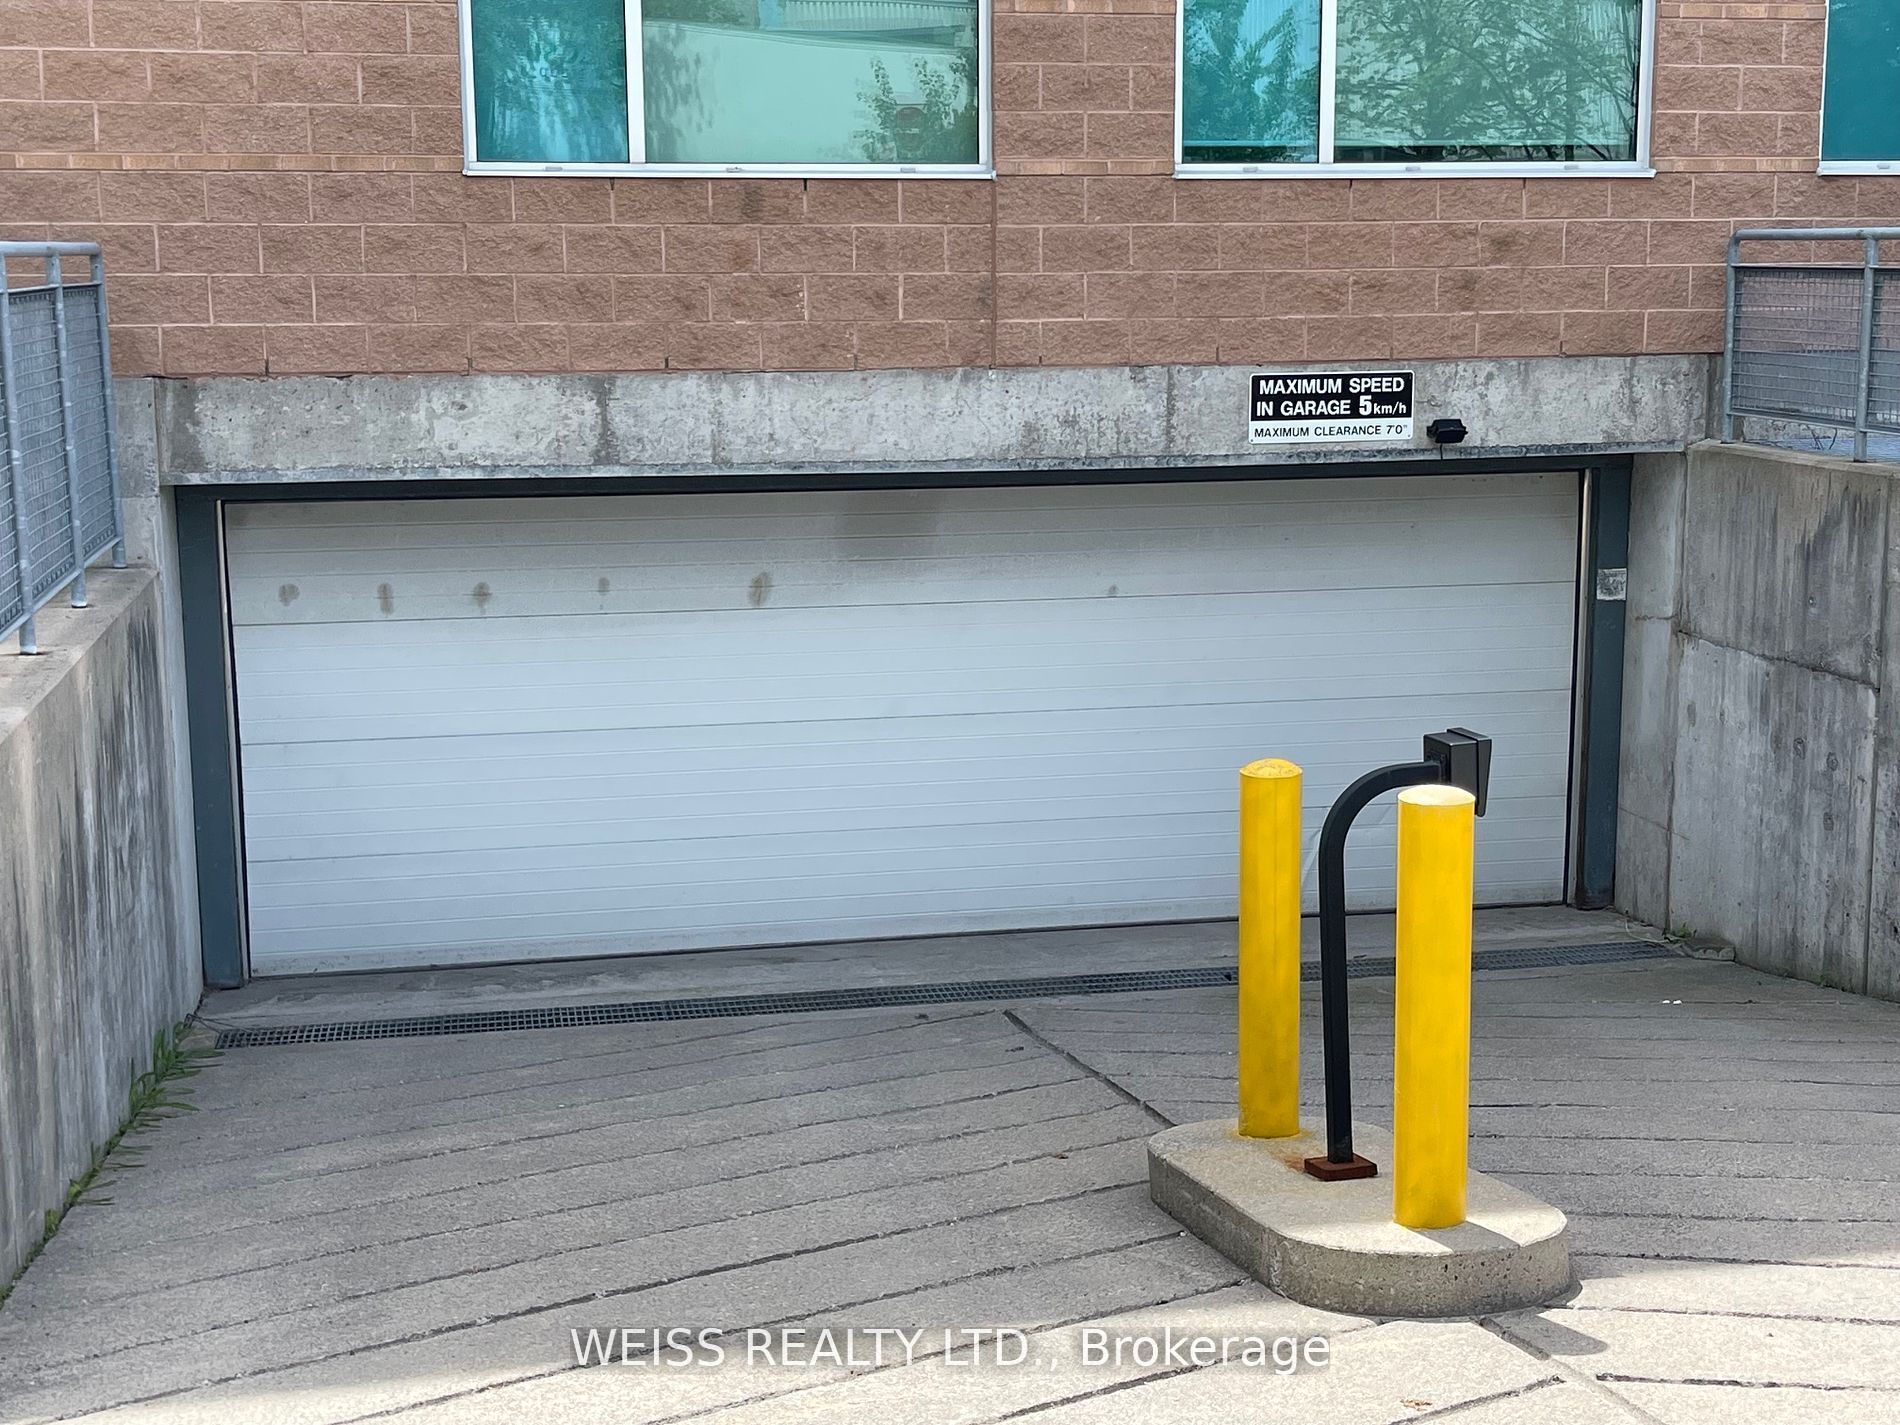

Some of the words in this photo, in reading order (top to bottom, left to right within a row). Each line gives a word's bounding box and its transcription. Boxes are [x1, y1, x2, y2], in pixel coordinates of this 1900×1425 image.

[1259, 378, 1342, 395] MAXIMUM
[1349, 377, 1405, 393] SPEED
[1256, 401, 1274, 417] IN
[1280, 399, 1351, 416] GARAGE
[1254, 426, 1310, 438] MAXIMUM
[1314, 424, 1382, 436] CLEARANCE
